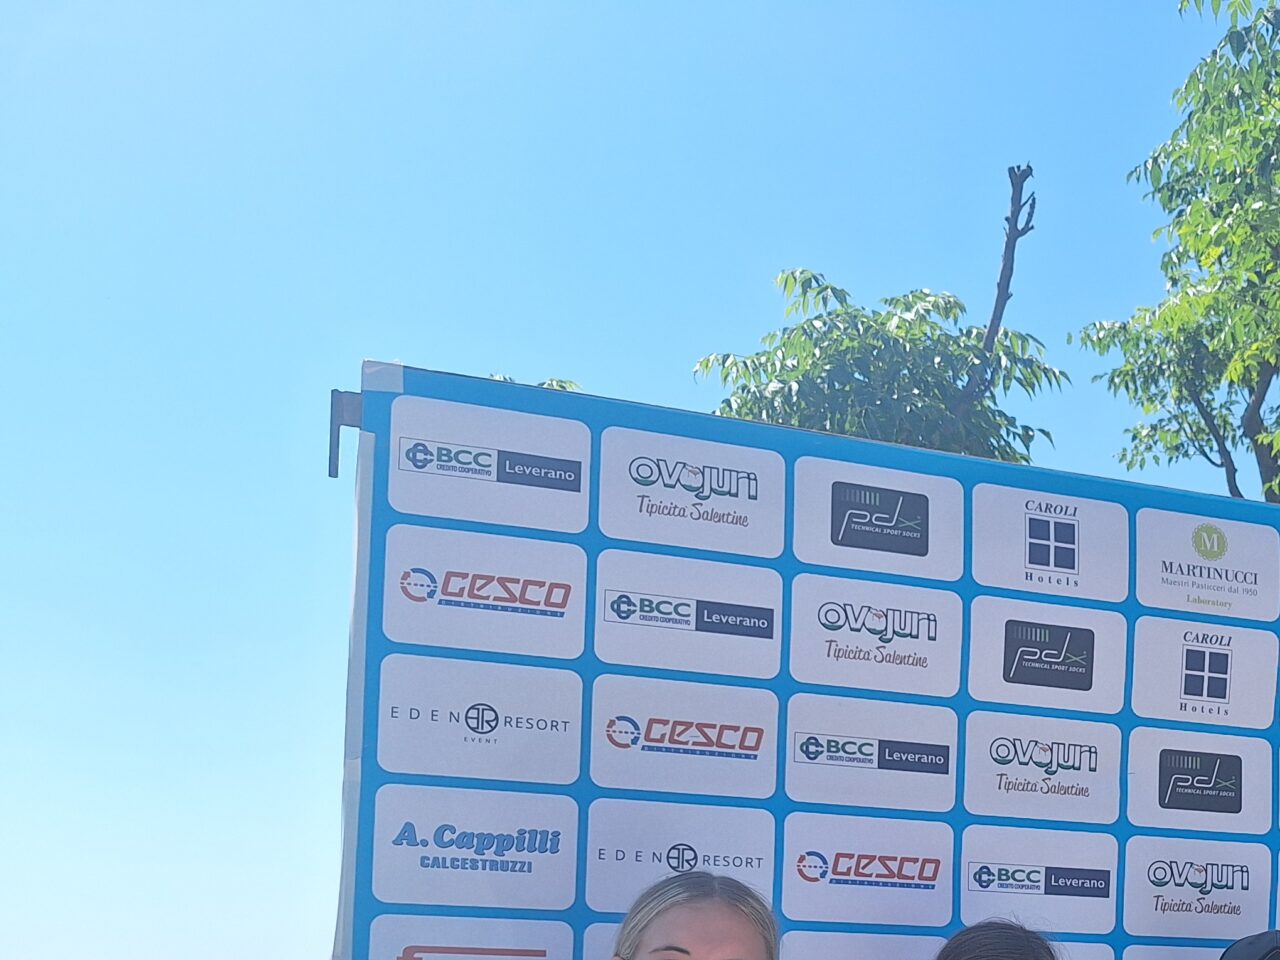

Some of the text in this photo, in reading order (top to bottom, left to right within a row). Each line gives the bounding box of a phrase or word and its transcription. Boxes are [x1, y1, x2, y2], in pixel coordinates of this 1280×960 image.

[436, 446, 576, 482] BCC Leverano
[690, 503, 750, 528] Salentine
[1025, 500, 1078, 517] CAROLI
[1025, 572, 1079, 588] Hotels
[1160, 560, 1259, 586] MARTINUCCI
[440, 570, 572, 610] GESCO
[1161, 577, 1189, 587] Maestri
[1228, 586, 1239, 594] dal
[1242, 588, 1258, 596] 1950
[639, 598, 768, 630] BCC Leverano
[1183, 630, 1232, 647] CAROLI
[874, 646, 929, 669] Salentine
[390, 705, 571, 733] EDEN RESORT
[1180, 702, 1229, 716] Hotels
[644, 718, 764, 752] GESCO
[827, 740, 944, 766] BCC Leverano
[1040, 777, 1090, 798] Salentine
[392, 820, 562, 857] A. Cappilli
[420, 854, 533, 874] CALCESTRUZZI
[598, 848, 764, 870] EDEN RESORT
[832, 852, 941, 882] GESCO
[998, 866, 1106, 890] BCC Leverano
[1194, 897, 1242, 917] Salentine
